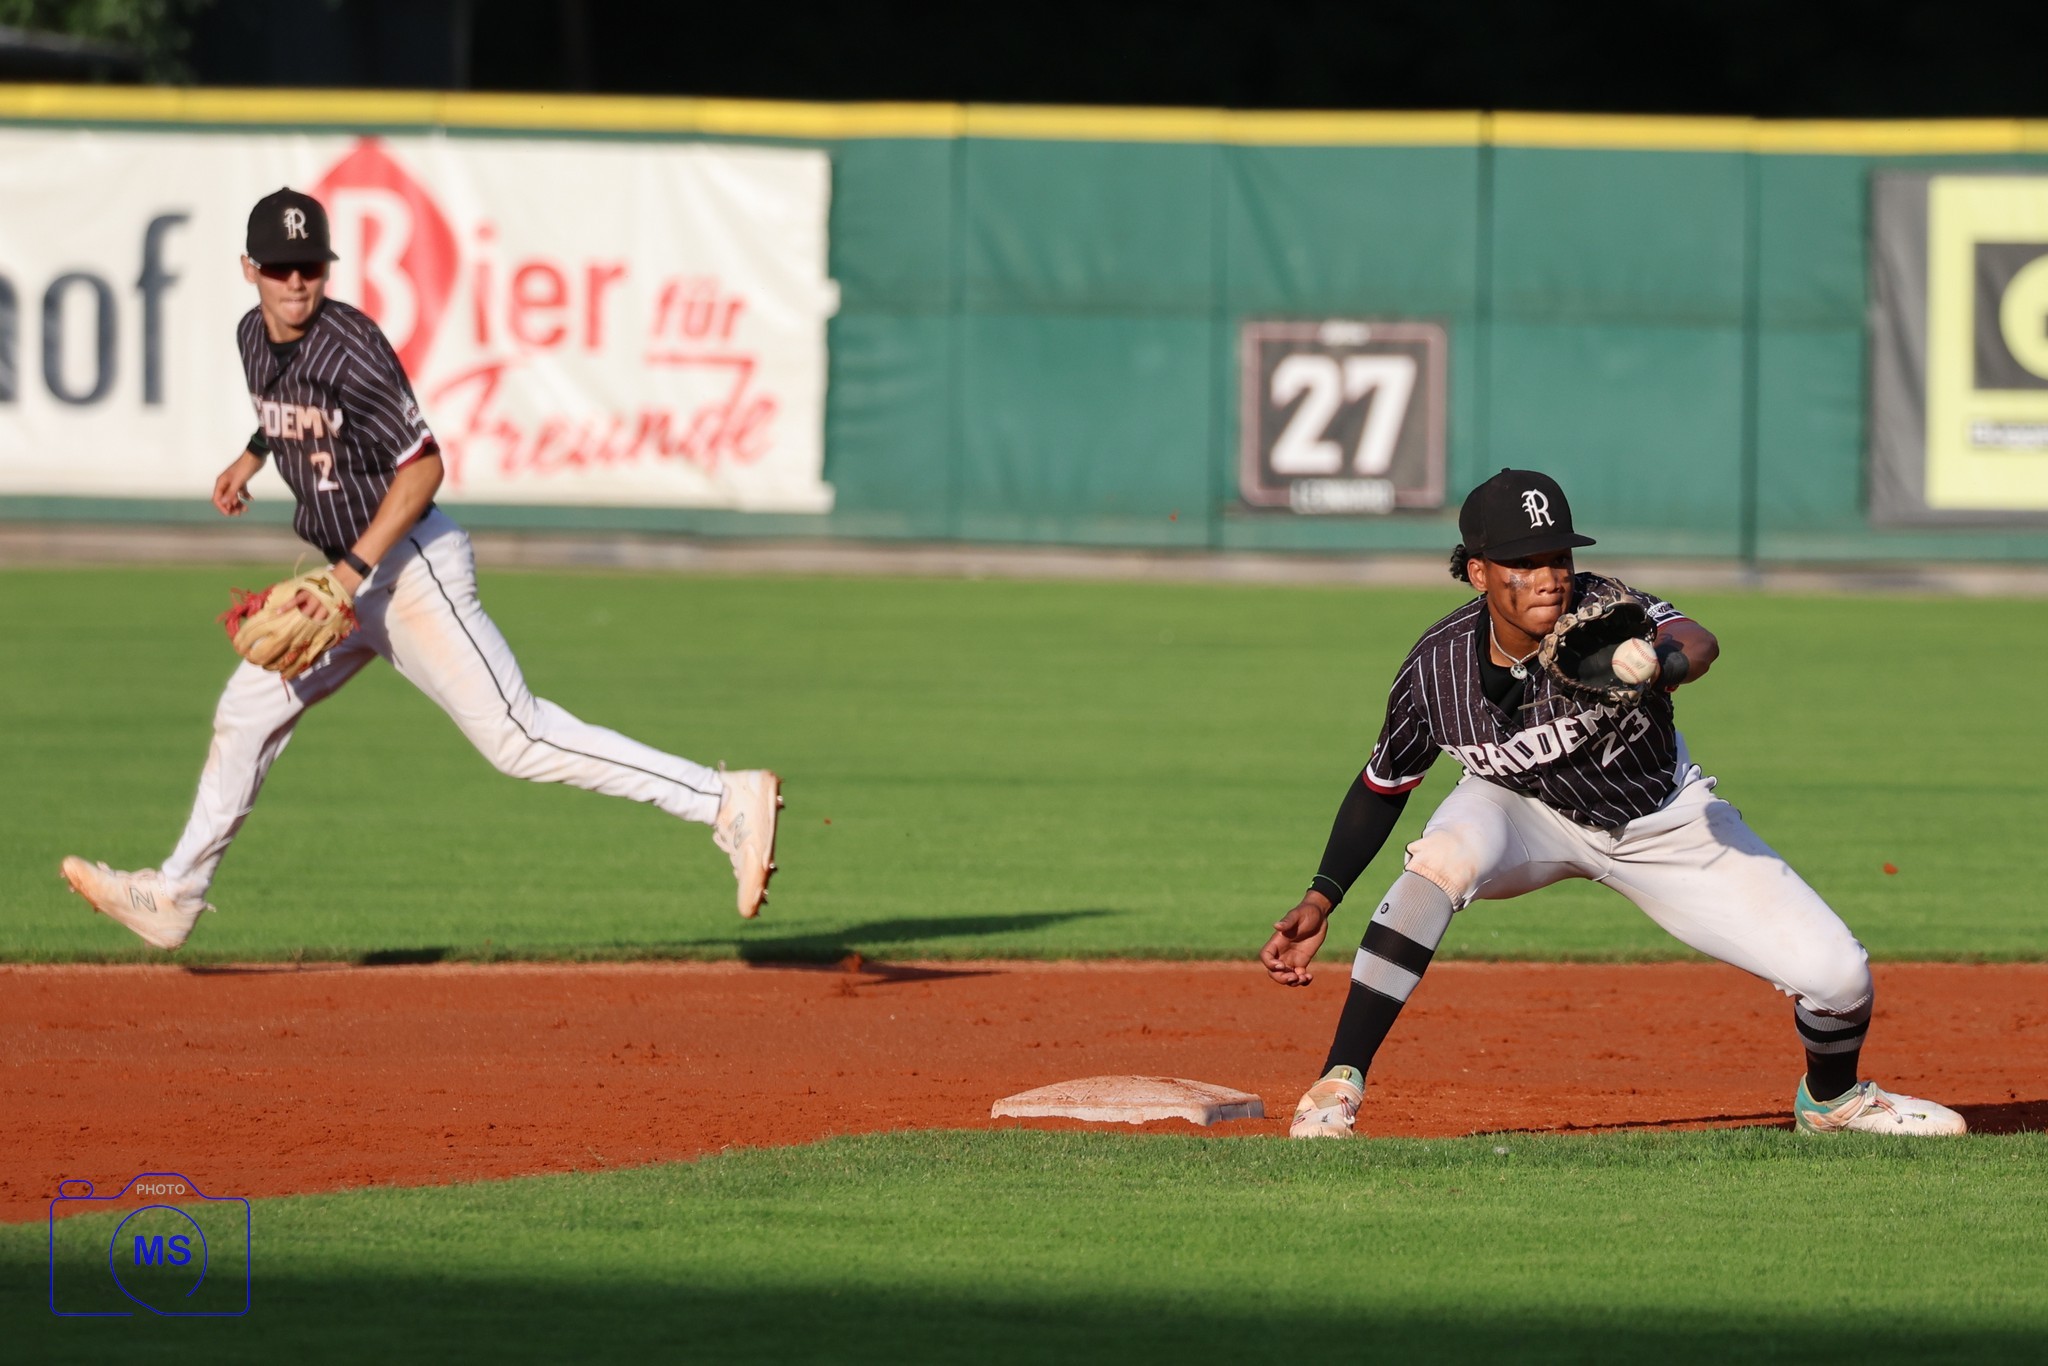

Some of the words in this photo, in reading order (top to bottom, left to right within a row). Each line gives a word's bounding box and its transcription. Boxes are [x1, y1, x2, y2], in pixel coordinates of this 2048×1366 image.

[283, 207, 309, 240] R
[0, 212, 190, 406] of
[332, 187, 627, 352] Bier
[652, 276, 746, 341] für
[428, 350, 778, 487] Freunde
[1270, 354, 1417, 475] 27
[310, 451, 340, 492] 2
[1520, 488, 1555, 529] R
[1592, 708, 1650, 768] 23
